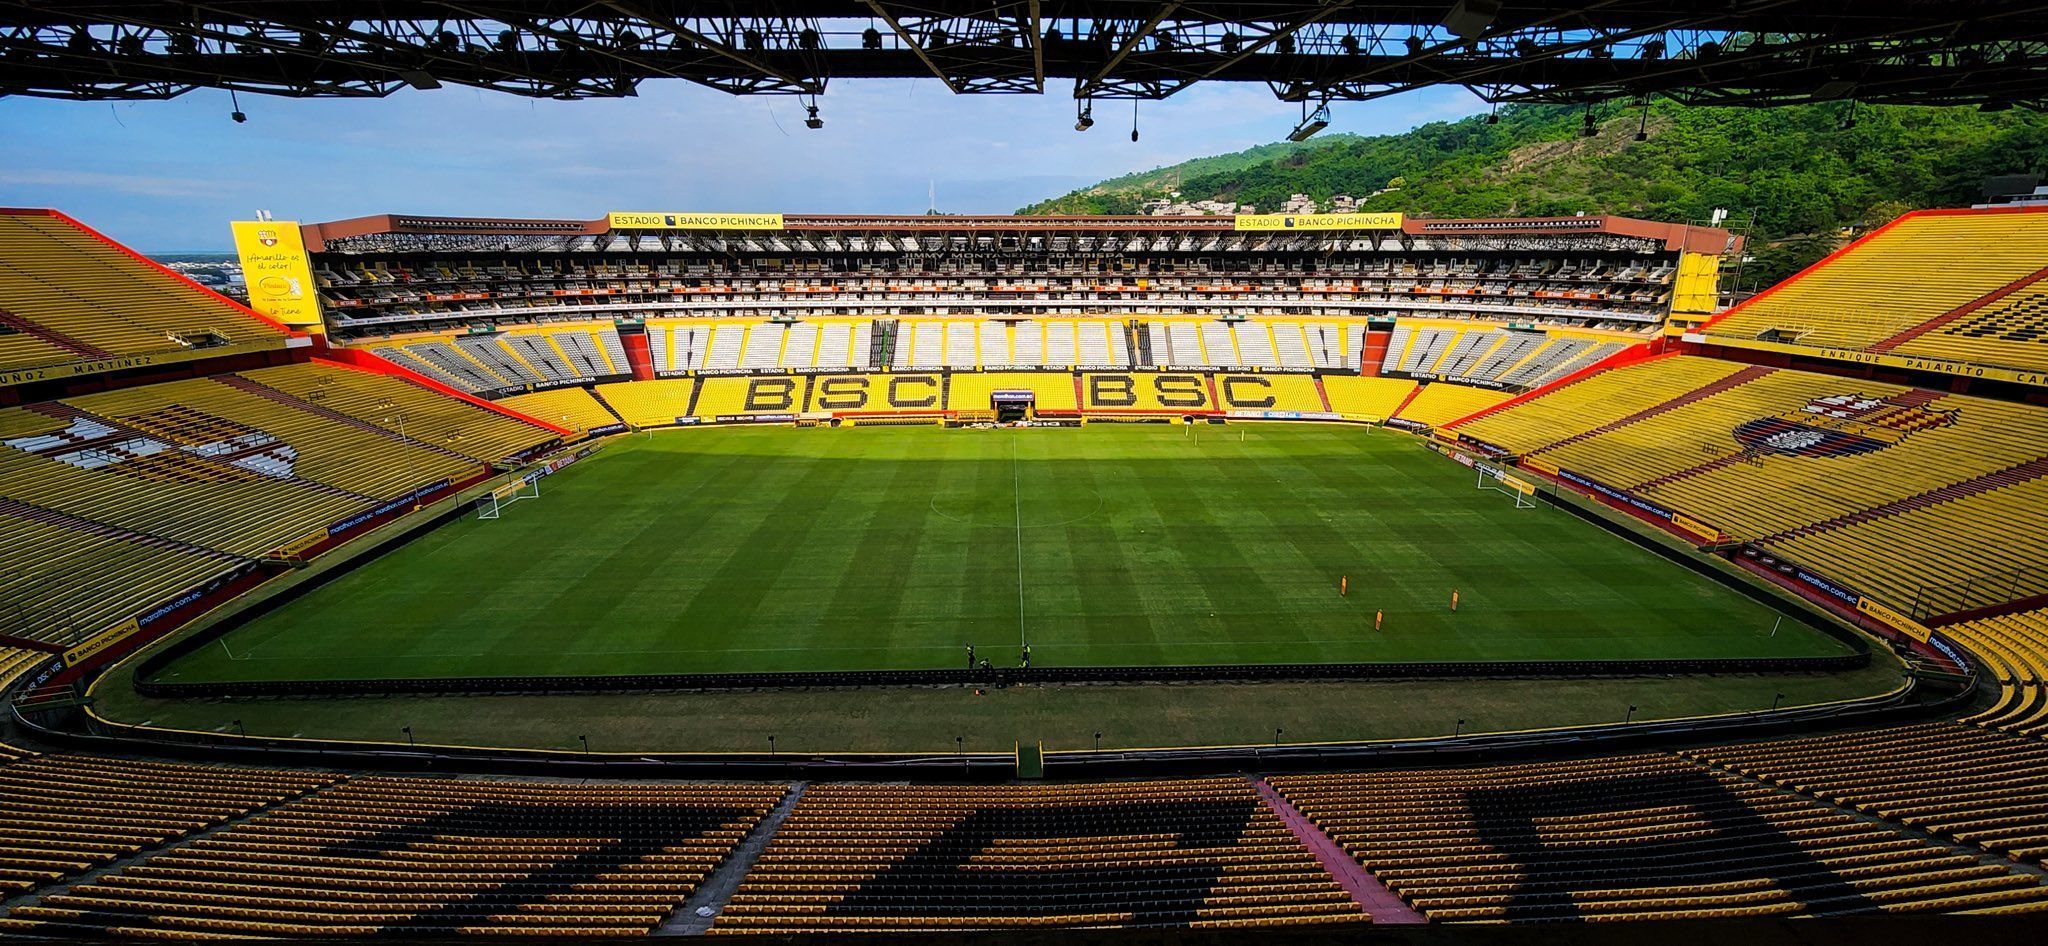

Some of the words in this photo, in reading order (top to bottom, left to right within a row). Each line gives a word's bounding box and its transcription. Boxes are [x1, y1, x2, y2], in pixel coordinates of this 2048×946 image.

[614, 216, 660, 225] ESTADIO
[680, 216, 718, 225] BANCO
[721, 217, 778, 226] PICHINCHA
[1239, 218, 1280, 227] ESTADIO
[1299, 217, 1333, 226] BANCO
[1337, 216, 1395, 225] PICHINCHA
[74, 357, 151, 374] MARTINEZ
[1821, 350, 1880, 363] ENRIQUE
[1906, 360, 1984, 376] PAJARITO
[560, 377, 595, 385] PICHINCHA
[1470, 378, 1503, 388] PICHINCHA
[330, 512, 374, 535] marathon.com.ec
[375, 495, 415, 515] marathon.com.ec
[1630, 499, 1671, 519] marathon.com.ec
[1798, 572, 1857, 604] marathon.com.ec
[77, 641, 101, 657] BANCO
[100, 624, 136, 645] PICHINCHA
[140, 591, 202, 626] marathon.com.ec
[1869, 606, 1891, 620] BANCO
[1891, 616, 1926, 638] PICHINCHA
